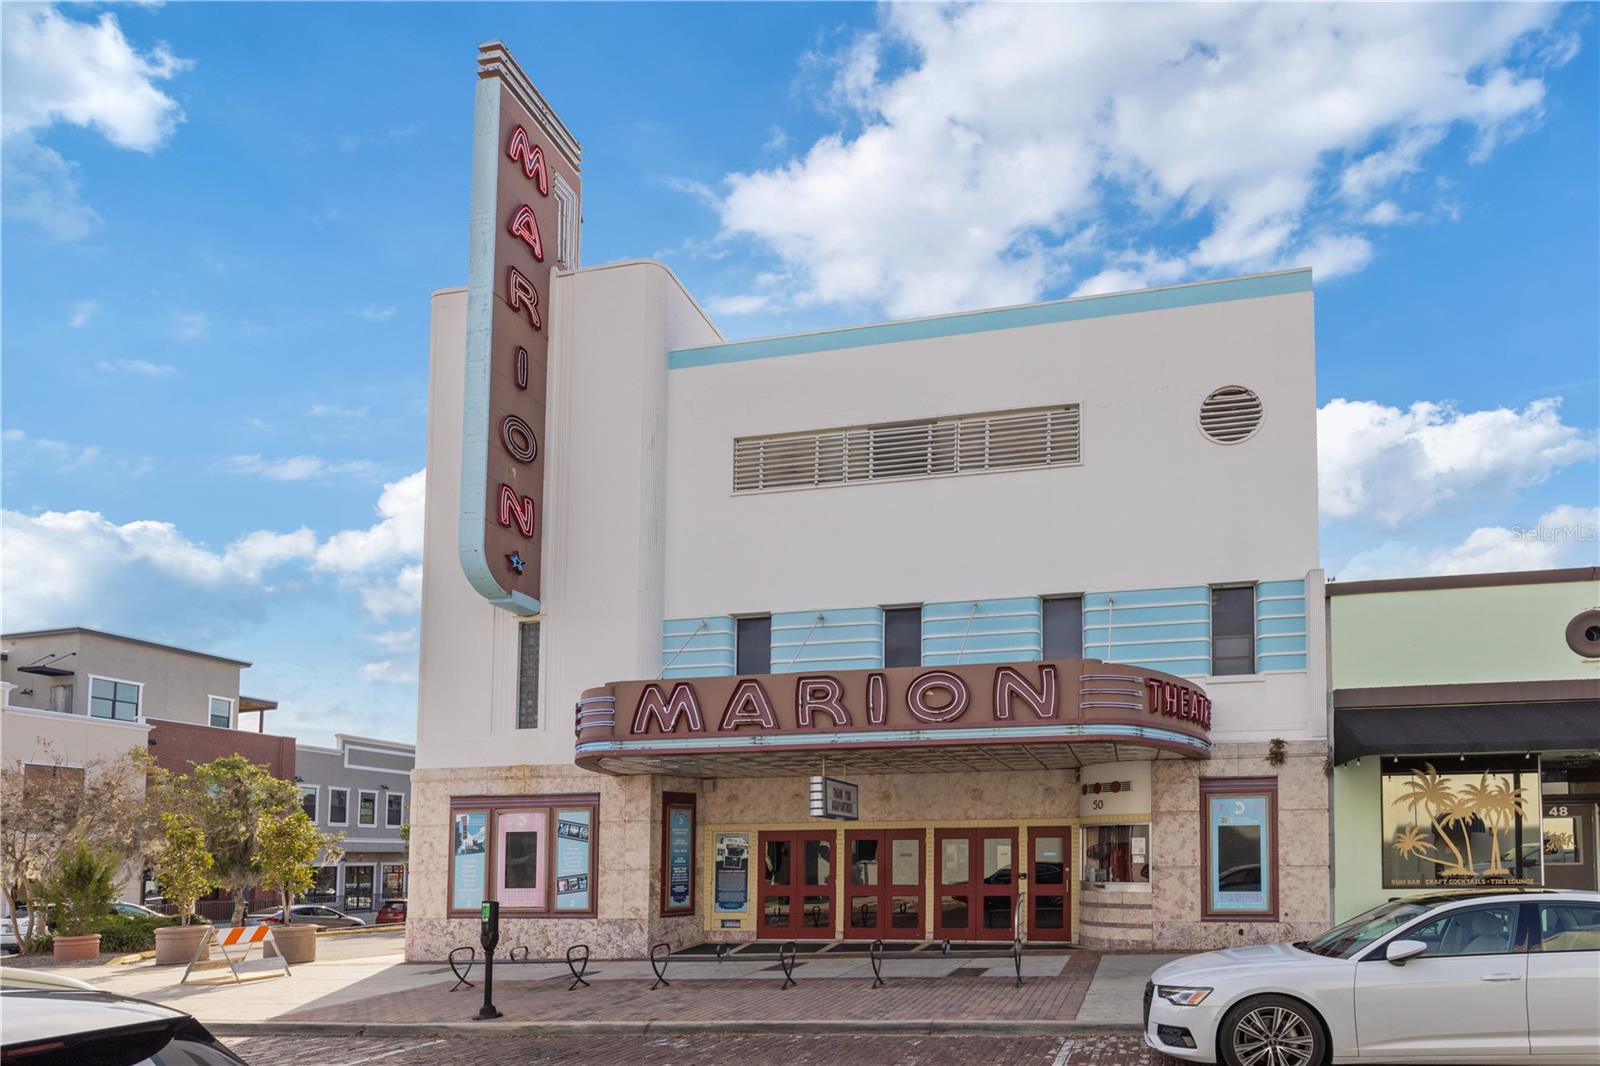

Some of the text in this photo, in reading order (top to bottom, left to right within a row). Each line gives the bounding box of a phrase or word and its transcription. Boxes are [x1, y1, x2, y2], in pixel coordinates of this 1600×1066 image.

[498, 124, 548, 537] MARION
[631, 664, 1059, 735] MARION
[1092, 799, 1104, 810] 50
[1549, 806, 1569, 816] 48
